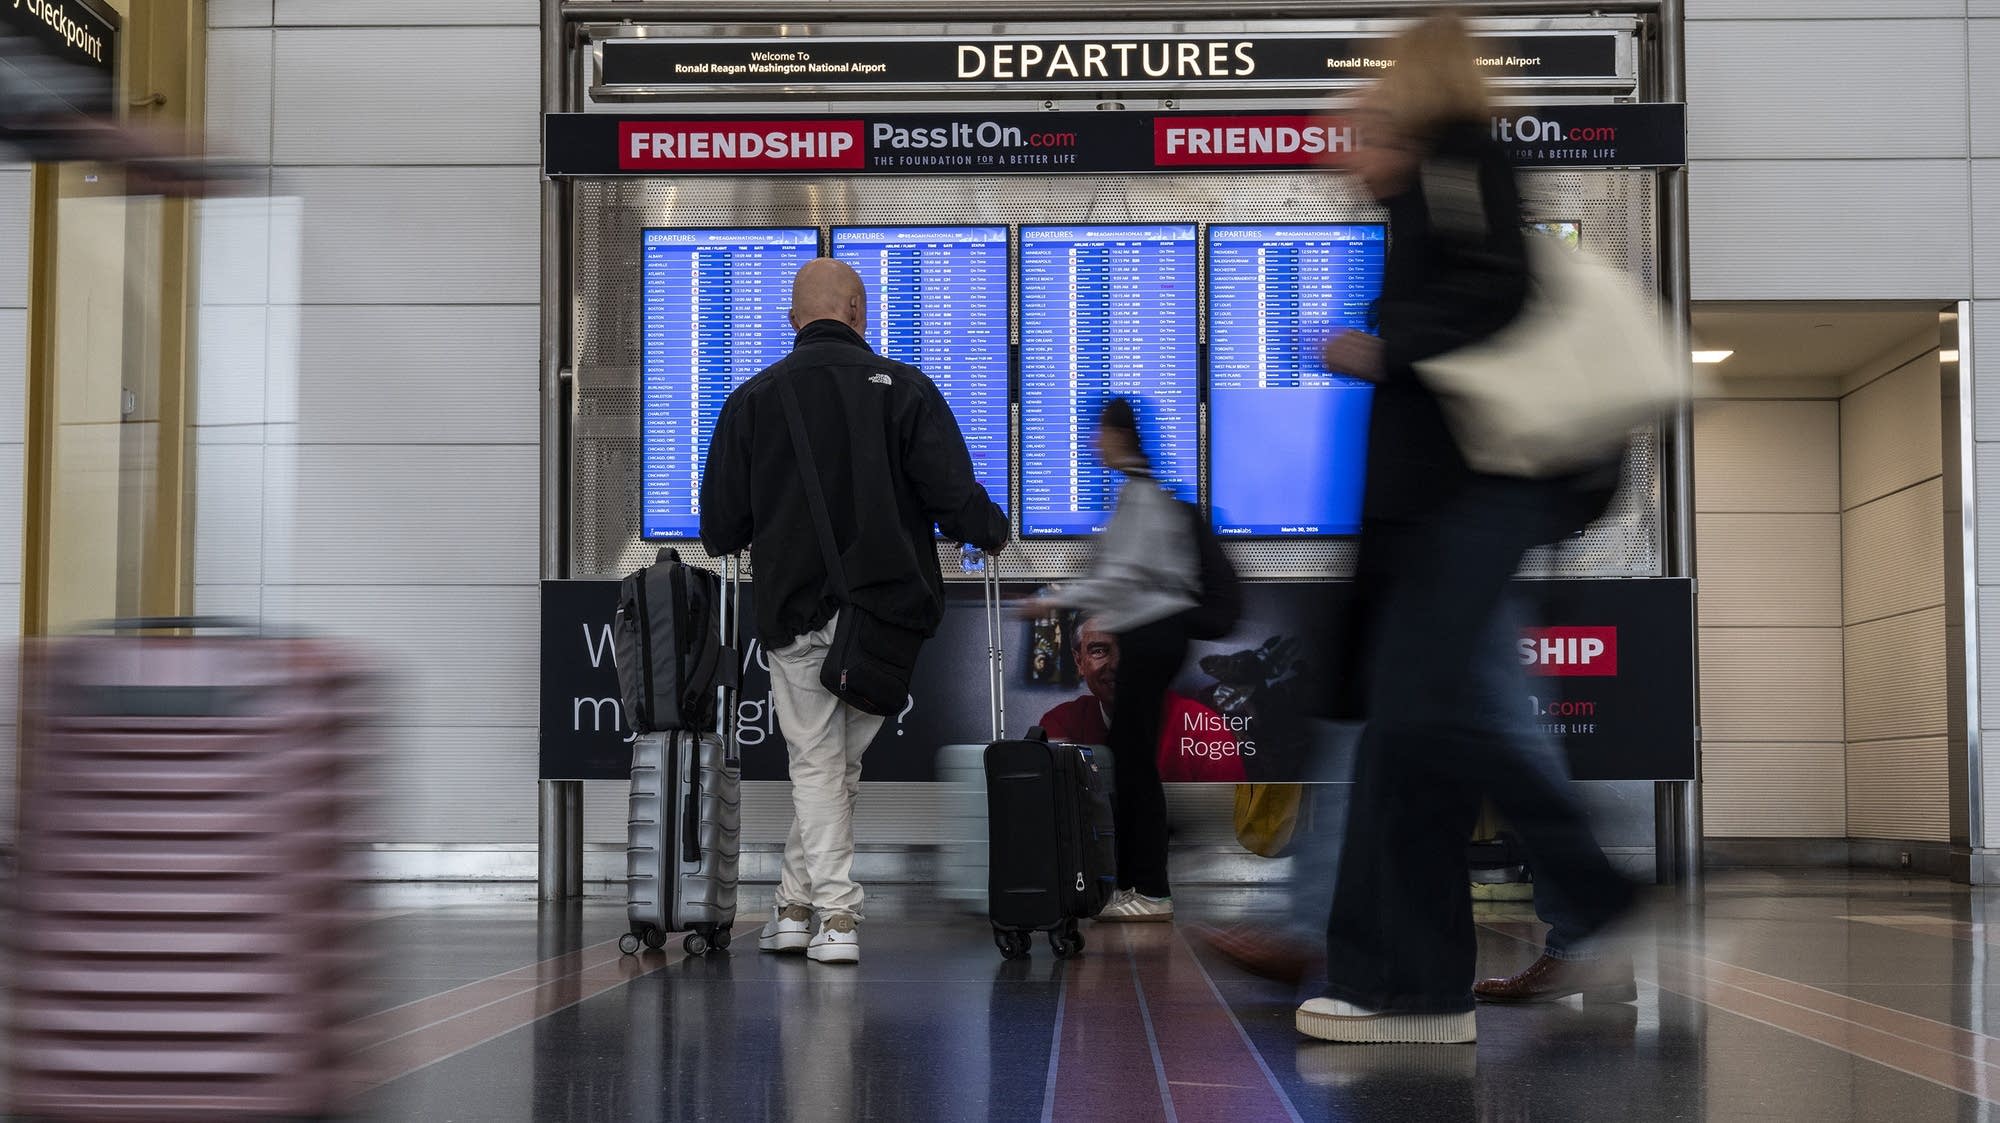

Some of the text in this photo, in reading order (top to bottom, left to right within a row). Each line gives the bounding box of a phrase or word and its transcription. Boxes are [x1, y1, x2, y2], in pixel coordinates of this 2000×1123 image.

[751, 51, 810, 61] Welcome To
[957, 42, 1256, 78] DEPARTURES
[1472, 56, 1541, 68] tional Airport
[675, 62, 886, 75] Ronald Reagan Washington National Airport
[1327, 58, 1361, 68] Ronald
[631, 132, 853, 159] FRIENDSHIP
[1166, 126, 1360, 154] FRIENDSH
[874, 154, 1076, 165] THE FOUNDATION FOR A BETTER LIFE
[1538, 150, 1545, 159] A
[1550, 149, 1588, 159] BETTER
[1593, 148, 1615, 158] LIFE
[837, 232, 885, 240] DEPARTURES
[1184, 712, 1253, 731] Mister
[1572, 723, 1594, 734] LIFE
[1180, 737, 1256, 760] Rogers
